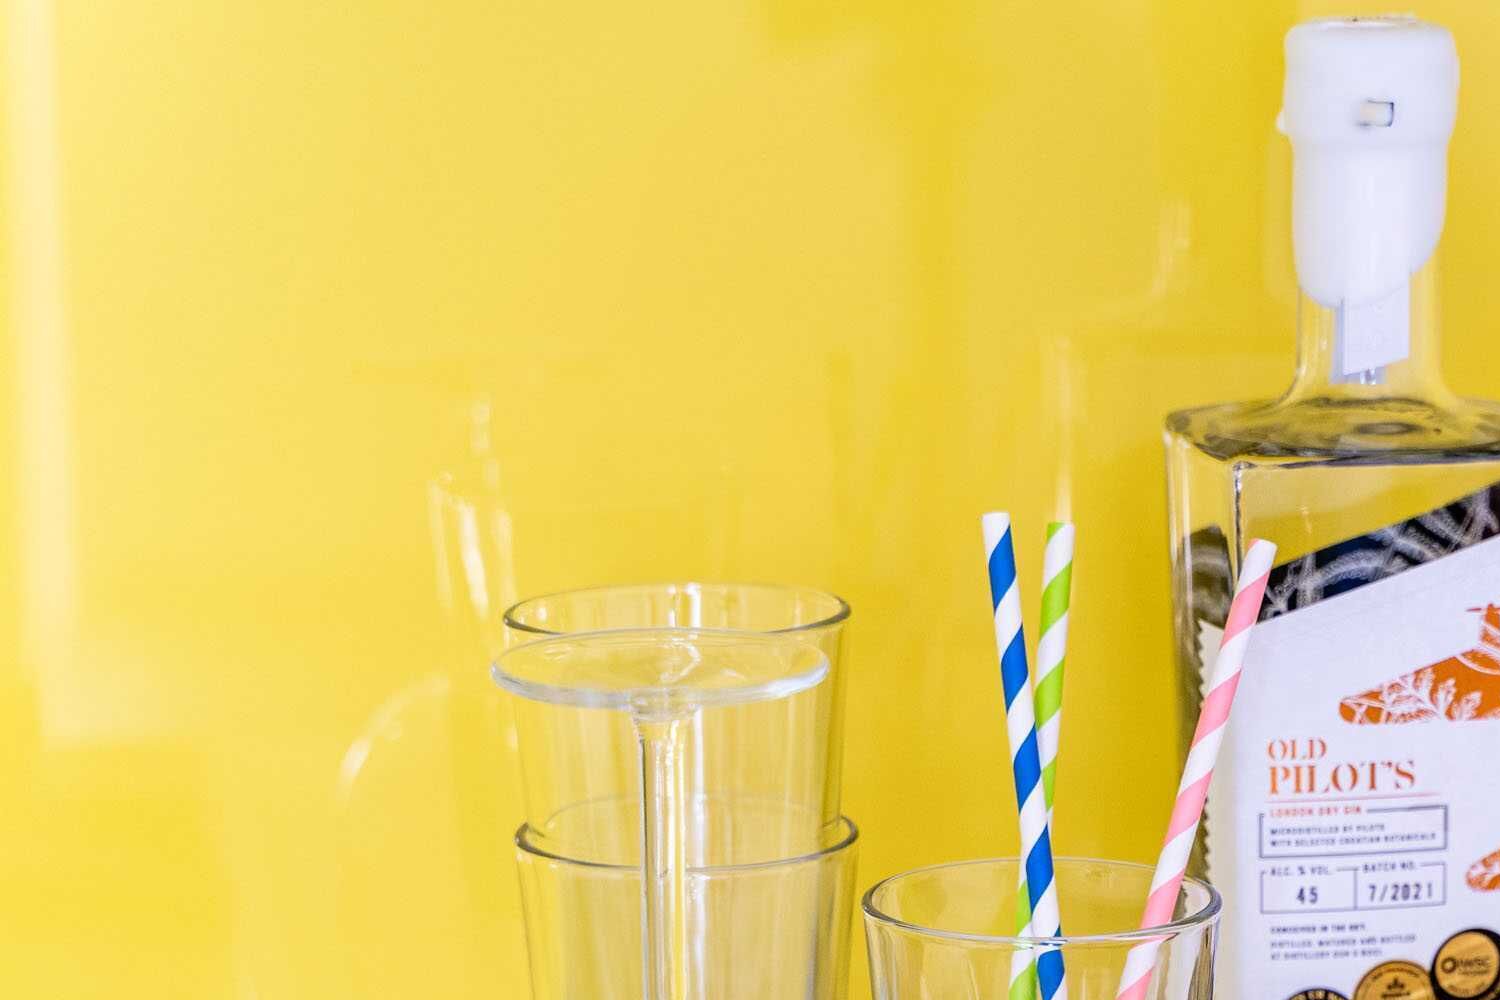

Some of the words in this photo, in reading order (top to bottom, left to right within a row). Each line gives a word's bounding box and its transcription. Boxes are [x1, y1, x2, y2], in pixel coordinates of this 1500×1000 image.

[1267, 738, 1327, 760] OLD
[1270, 808, 1314, 818] LONDON
[1318, 807, 1338, 816] DRY
[1343, 806, 1362, 814] GIN
[1362, 862, 1396, 873] BATCH
[1296, 886, 1319, 904] 45
[1368, 882, 1433, 902] 7/2021
